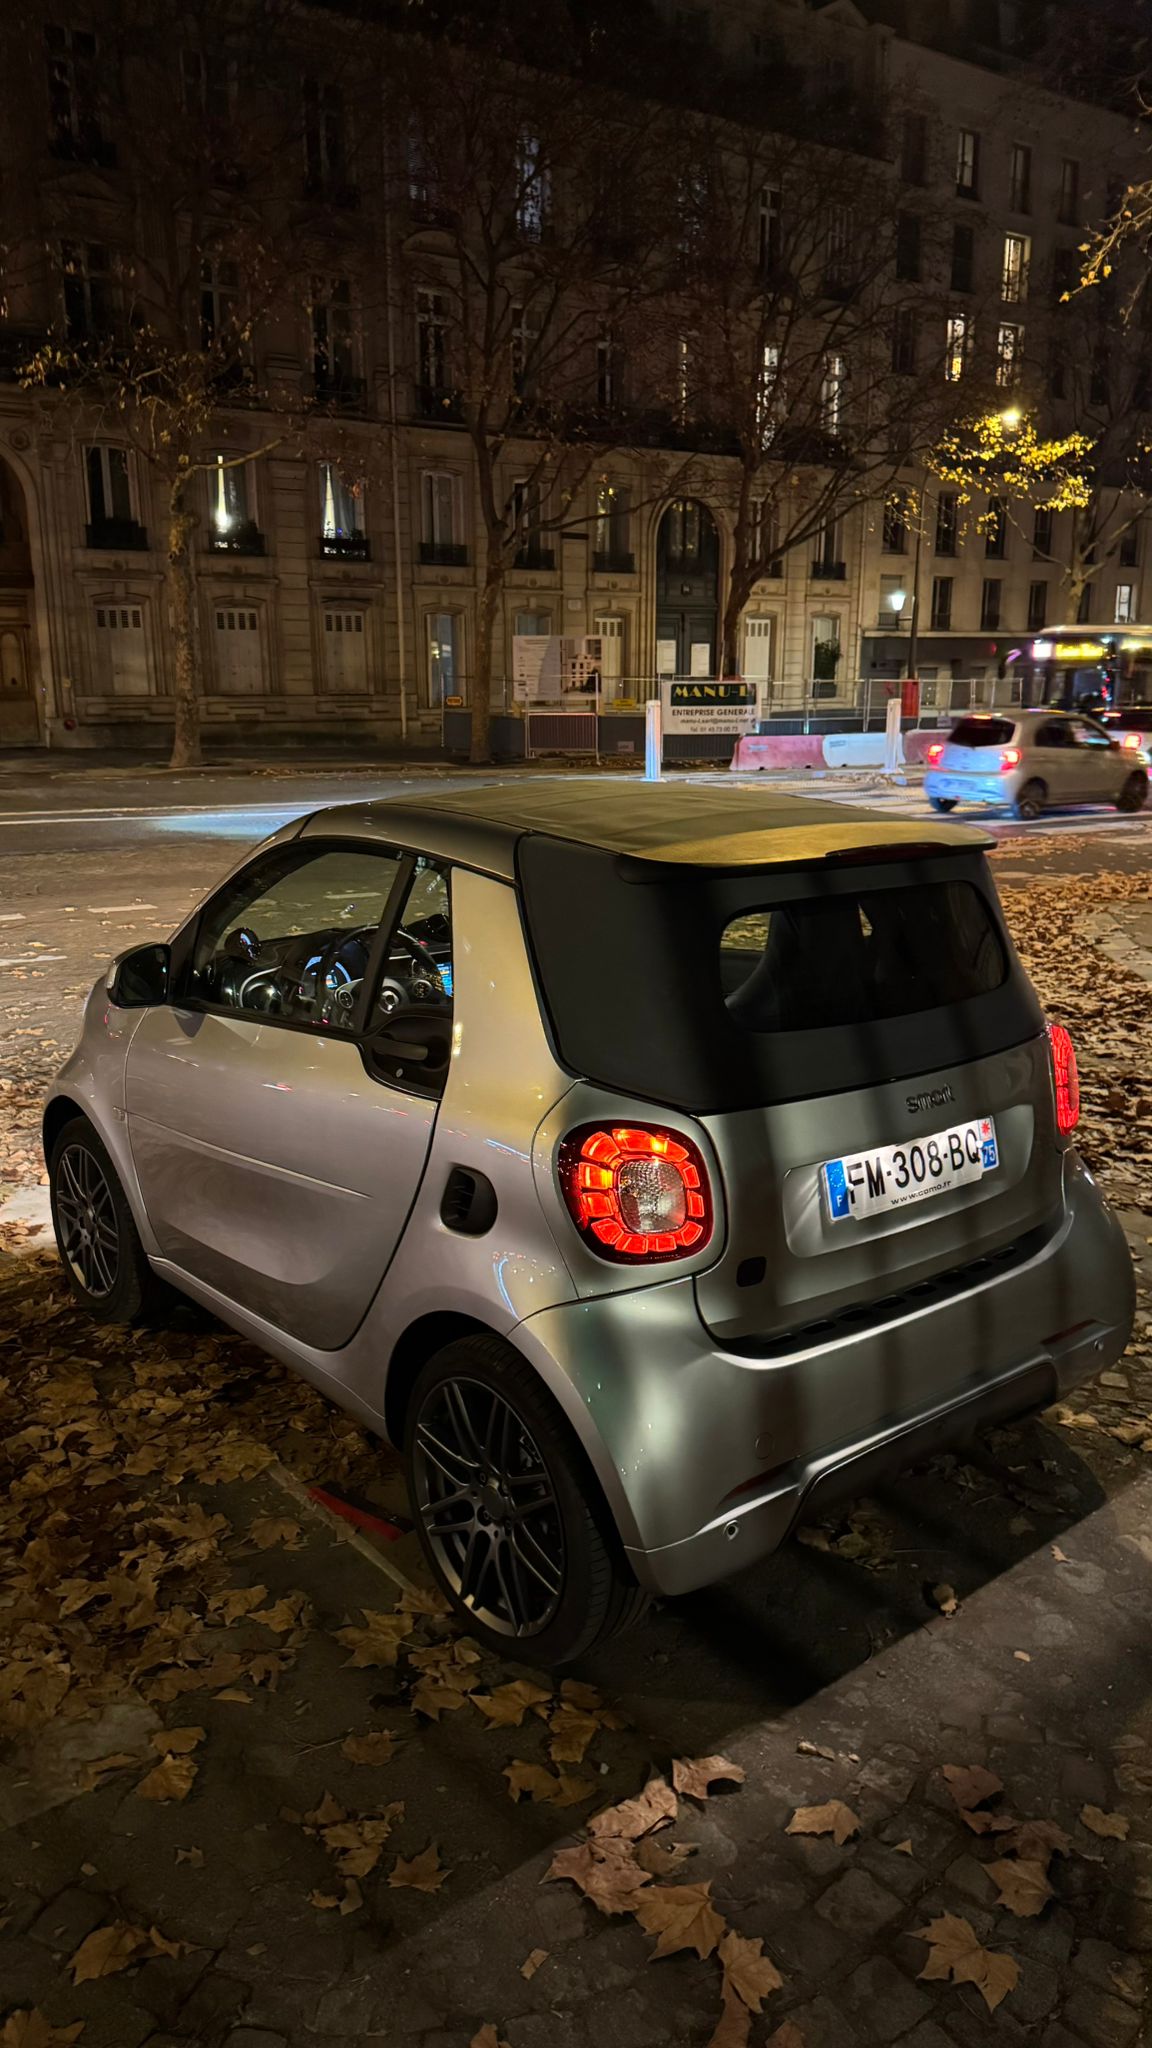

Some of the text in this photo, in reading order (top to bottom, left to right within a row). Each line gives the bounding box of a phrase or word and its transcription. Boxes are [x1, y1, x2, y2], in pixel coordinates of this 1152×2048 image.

[672, 708, 714, 716] ENTREPRISE
[983, 1145, 996, 1164] 75
[847, 1129, 981, 1204] FM-308-BQ
[836, 1195, 843, 1208] F
